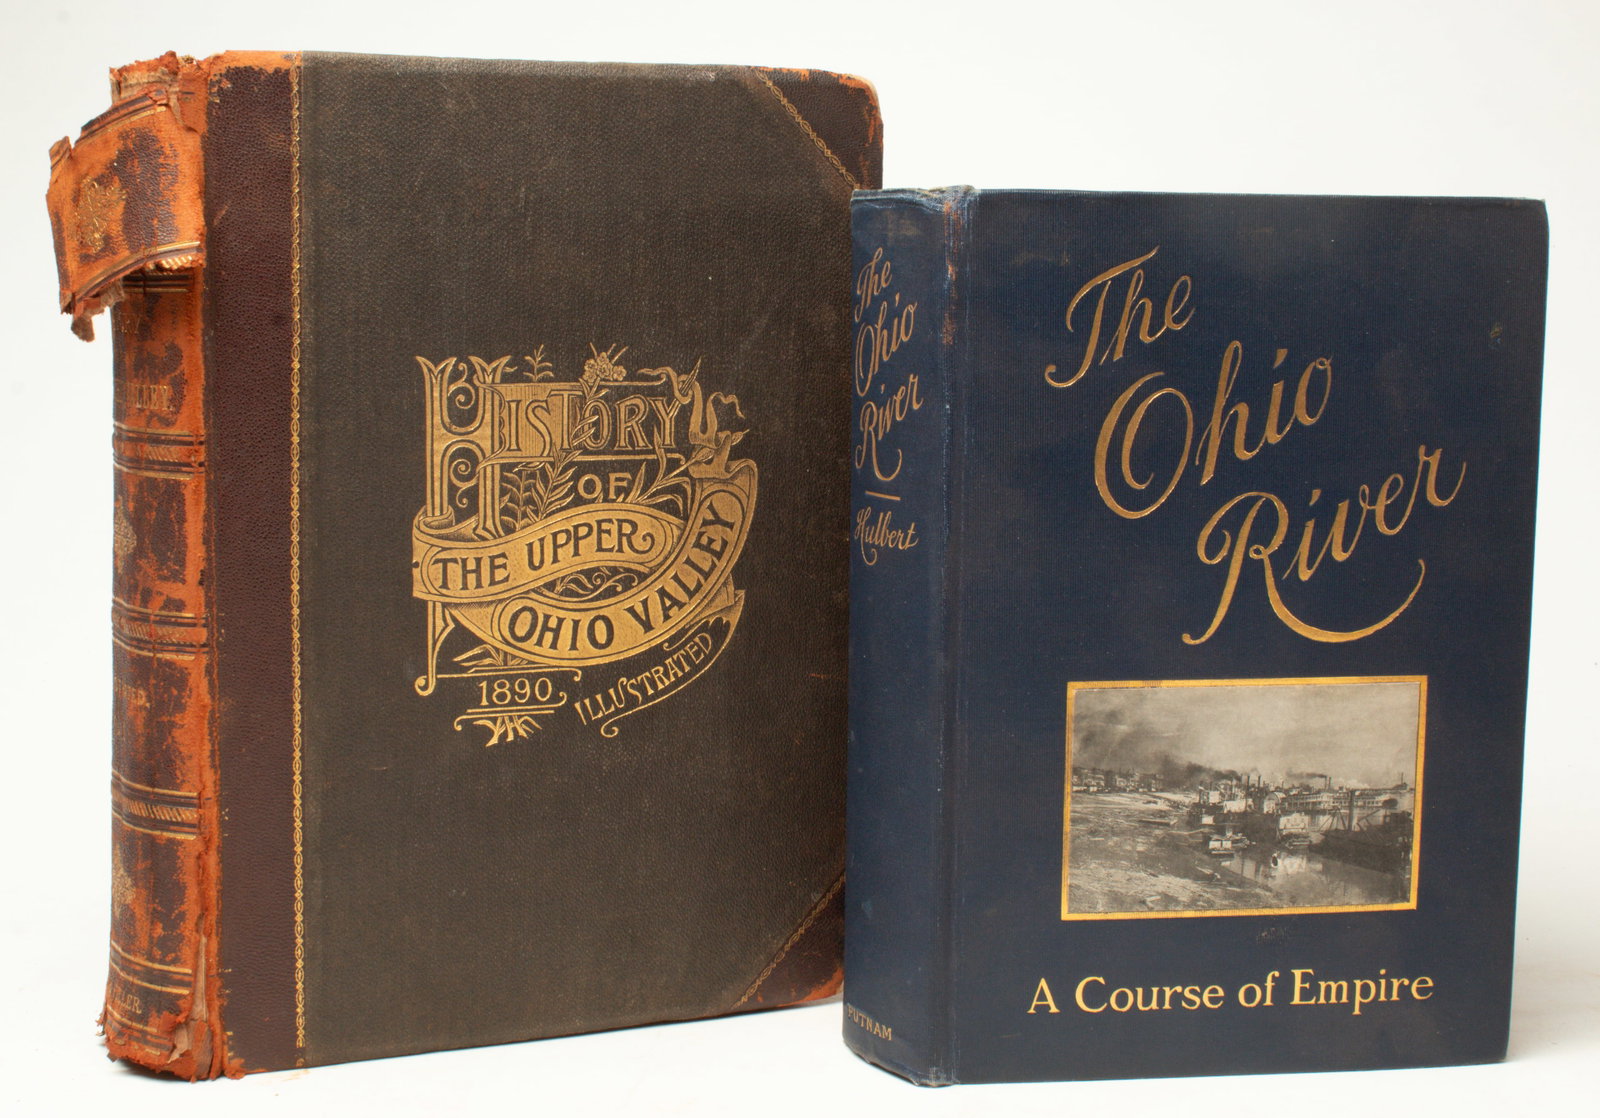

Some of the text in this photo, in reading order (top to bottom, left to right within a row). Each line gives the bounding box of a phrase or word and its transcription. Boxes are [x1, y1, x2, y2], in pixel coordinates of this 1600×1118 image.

[855, 247, 893, 323] The
[1044, 245, 1196, 388] The
[855, 293, 918, 397] Ohio
[855, 373, 924, 481] River
[1094, 340, 1333, 520] Ohio
[577, 473, 633, 499] OF
[432, 517, 656, 591] THE UPPER
[508, 500, 736, 651] OHIO VALLEY
[854, 506, 919, 566] Hulbert
[1182, 445, 1467, 645] River
[478, 677, 553, 706] 1890
[574, 631, 713, 726] ILLUSTRATED
[847, 1003, 893, 1041] PUTNAM
[1027, 968, 1435, 1016] A Course of Empire
